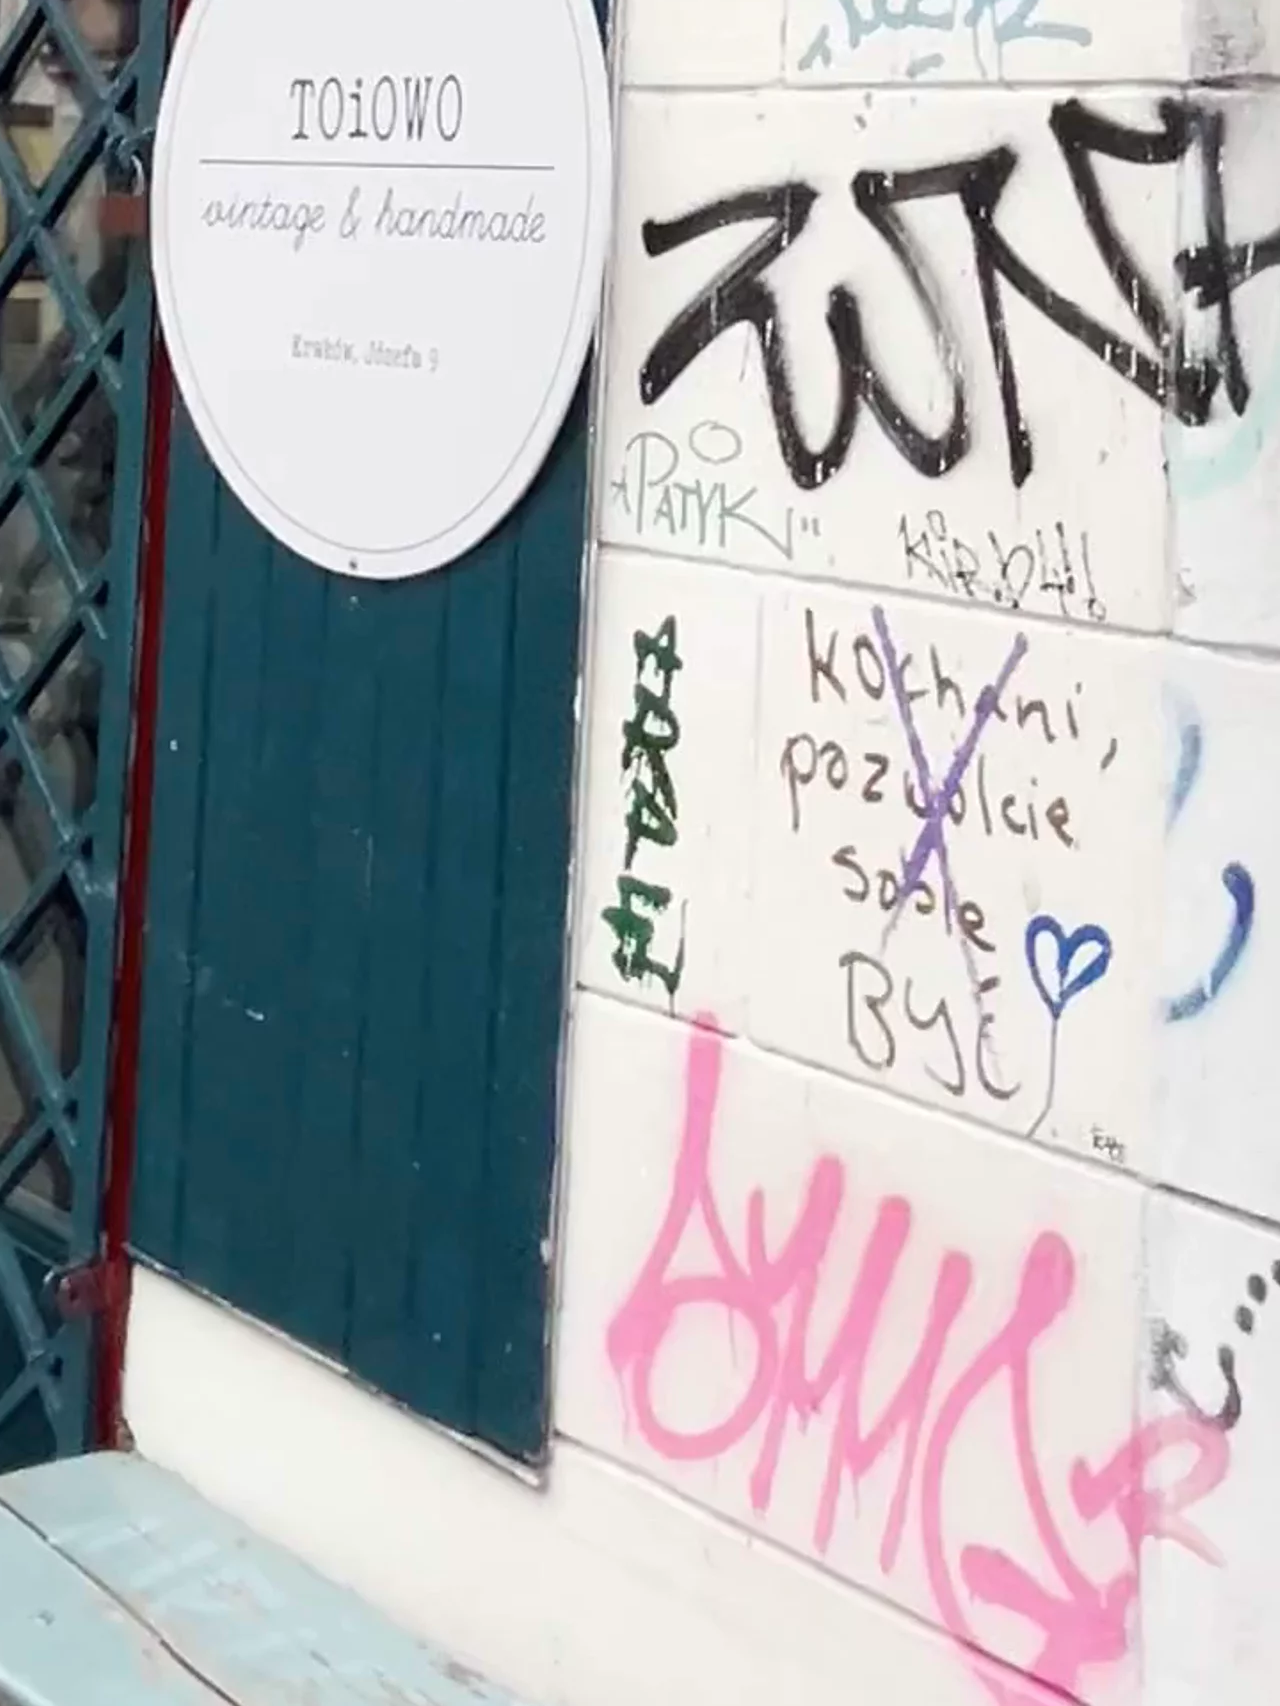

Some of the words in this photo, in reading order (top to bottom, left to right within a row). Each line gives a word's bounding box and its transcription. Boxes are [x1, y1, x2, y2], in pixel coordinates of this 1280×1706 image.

[290, 74, 463, 142] TOiOWO
[201, 190, 326, 253] vintage
[339, 185, 362, 241] &
[375, 186, 546, 243] handmade
